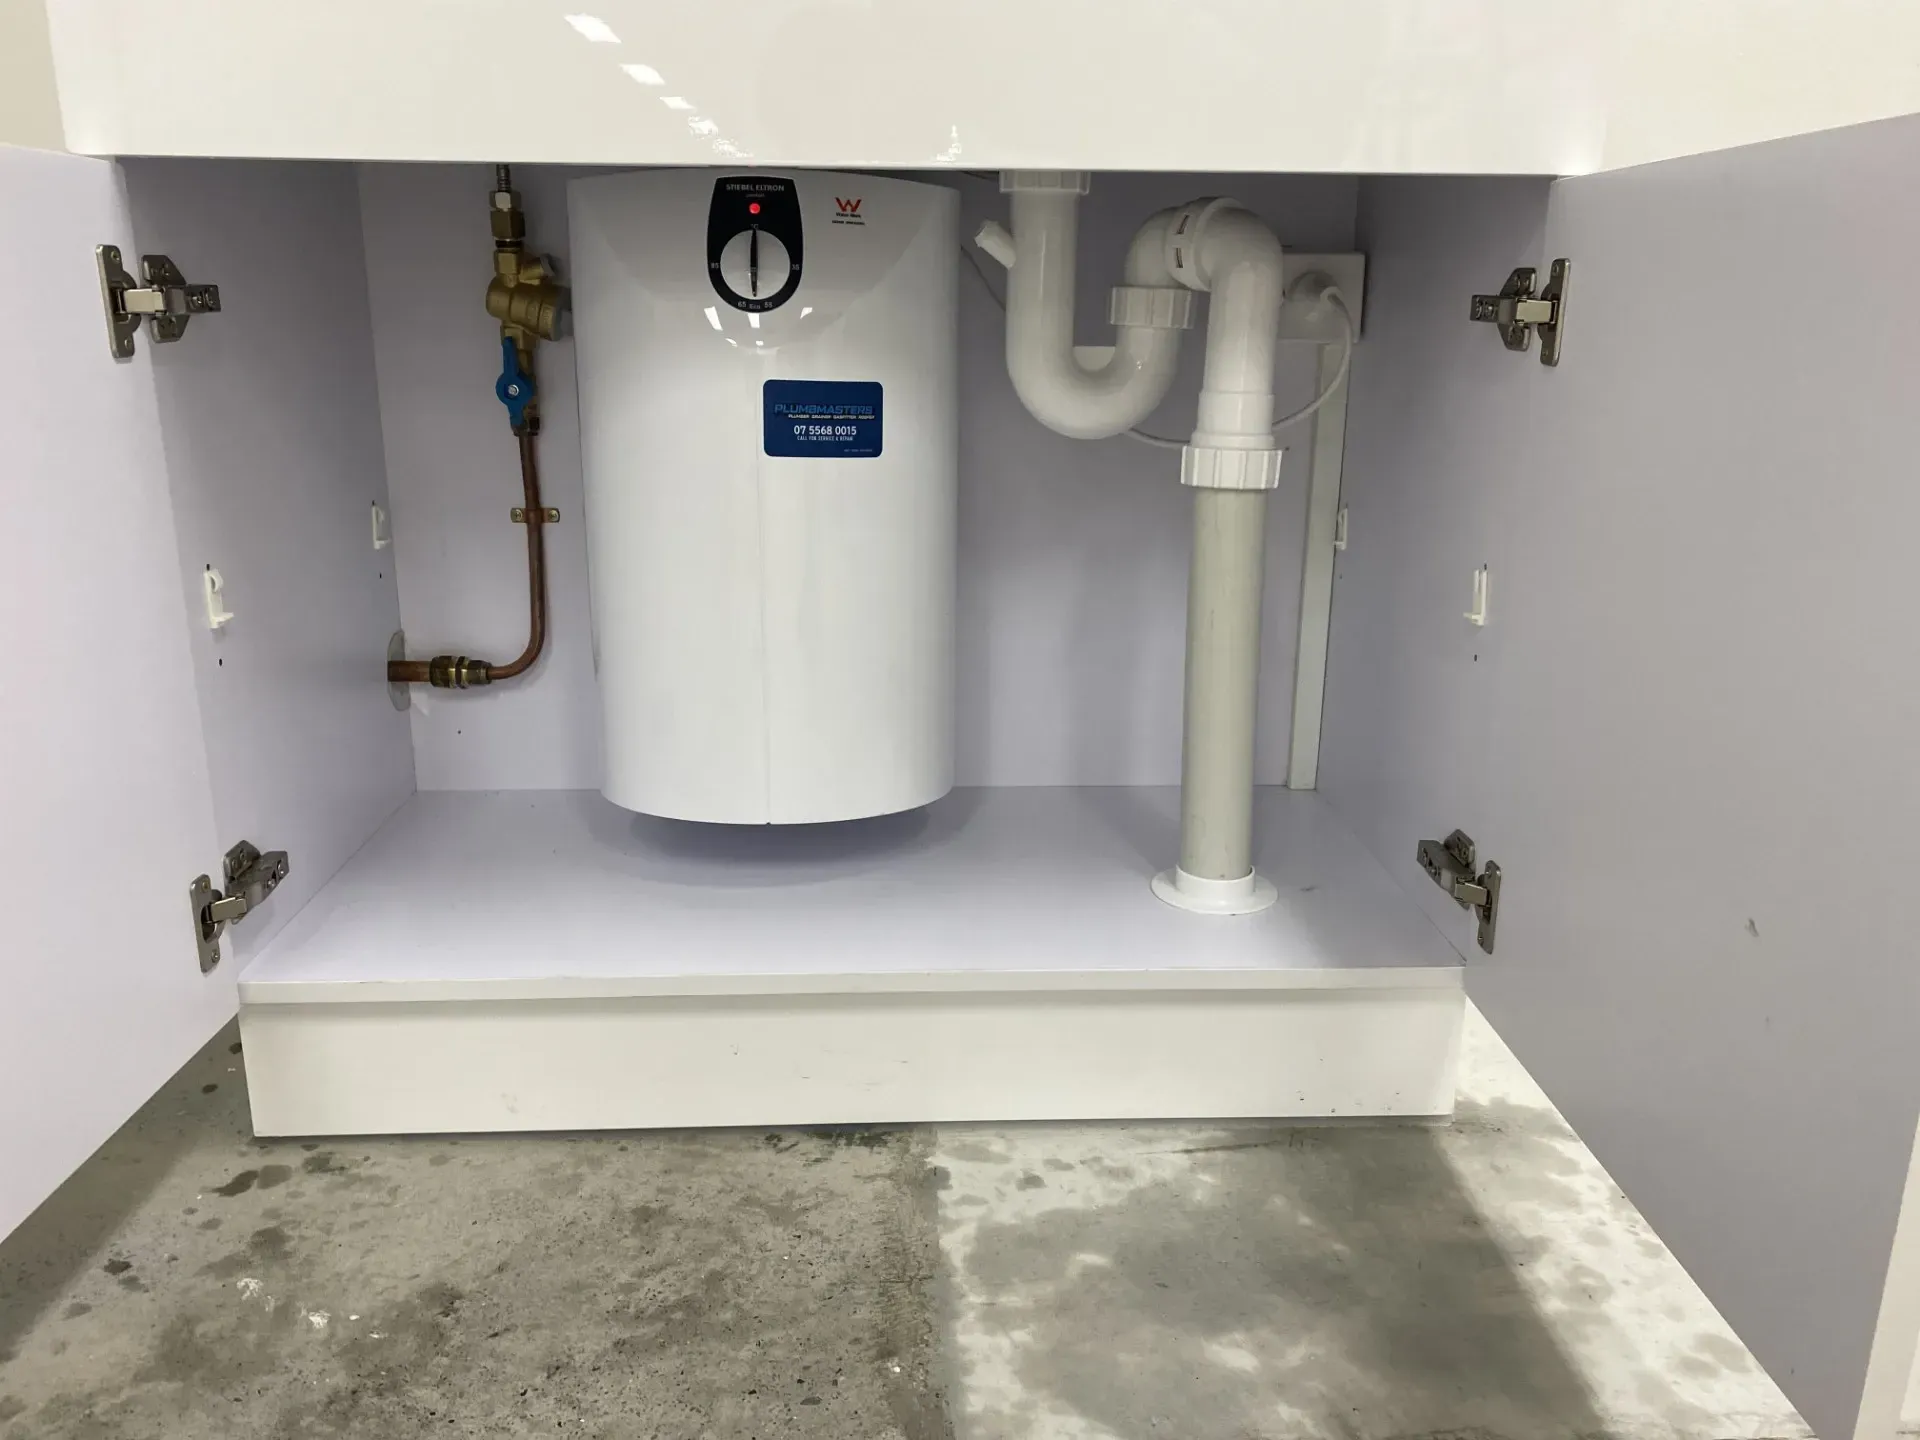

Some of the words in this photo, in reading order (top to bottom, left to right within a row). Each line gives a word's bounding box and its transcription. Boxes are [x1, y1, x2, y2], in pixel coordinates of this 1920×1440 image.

[726, 183, 754, 191] STIEBEL
[756, 184, 785, 192] ELTRON
[775, 404, 873, 414] PLUMBMASTERS
[794, 425, 806, 435] 07
[808, 425, 833, 435] 5568
[834, 425, 857, 436] 0015
